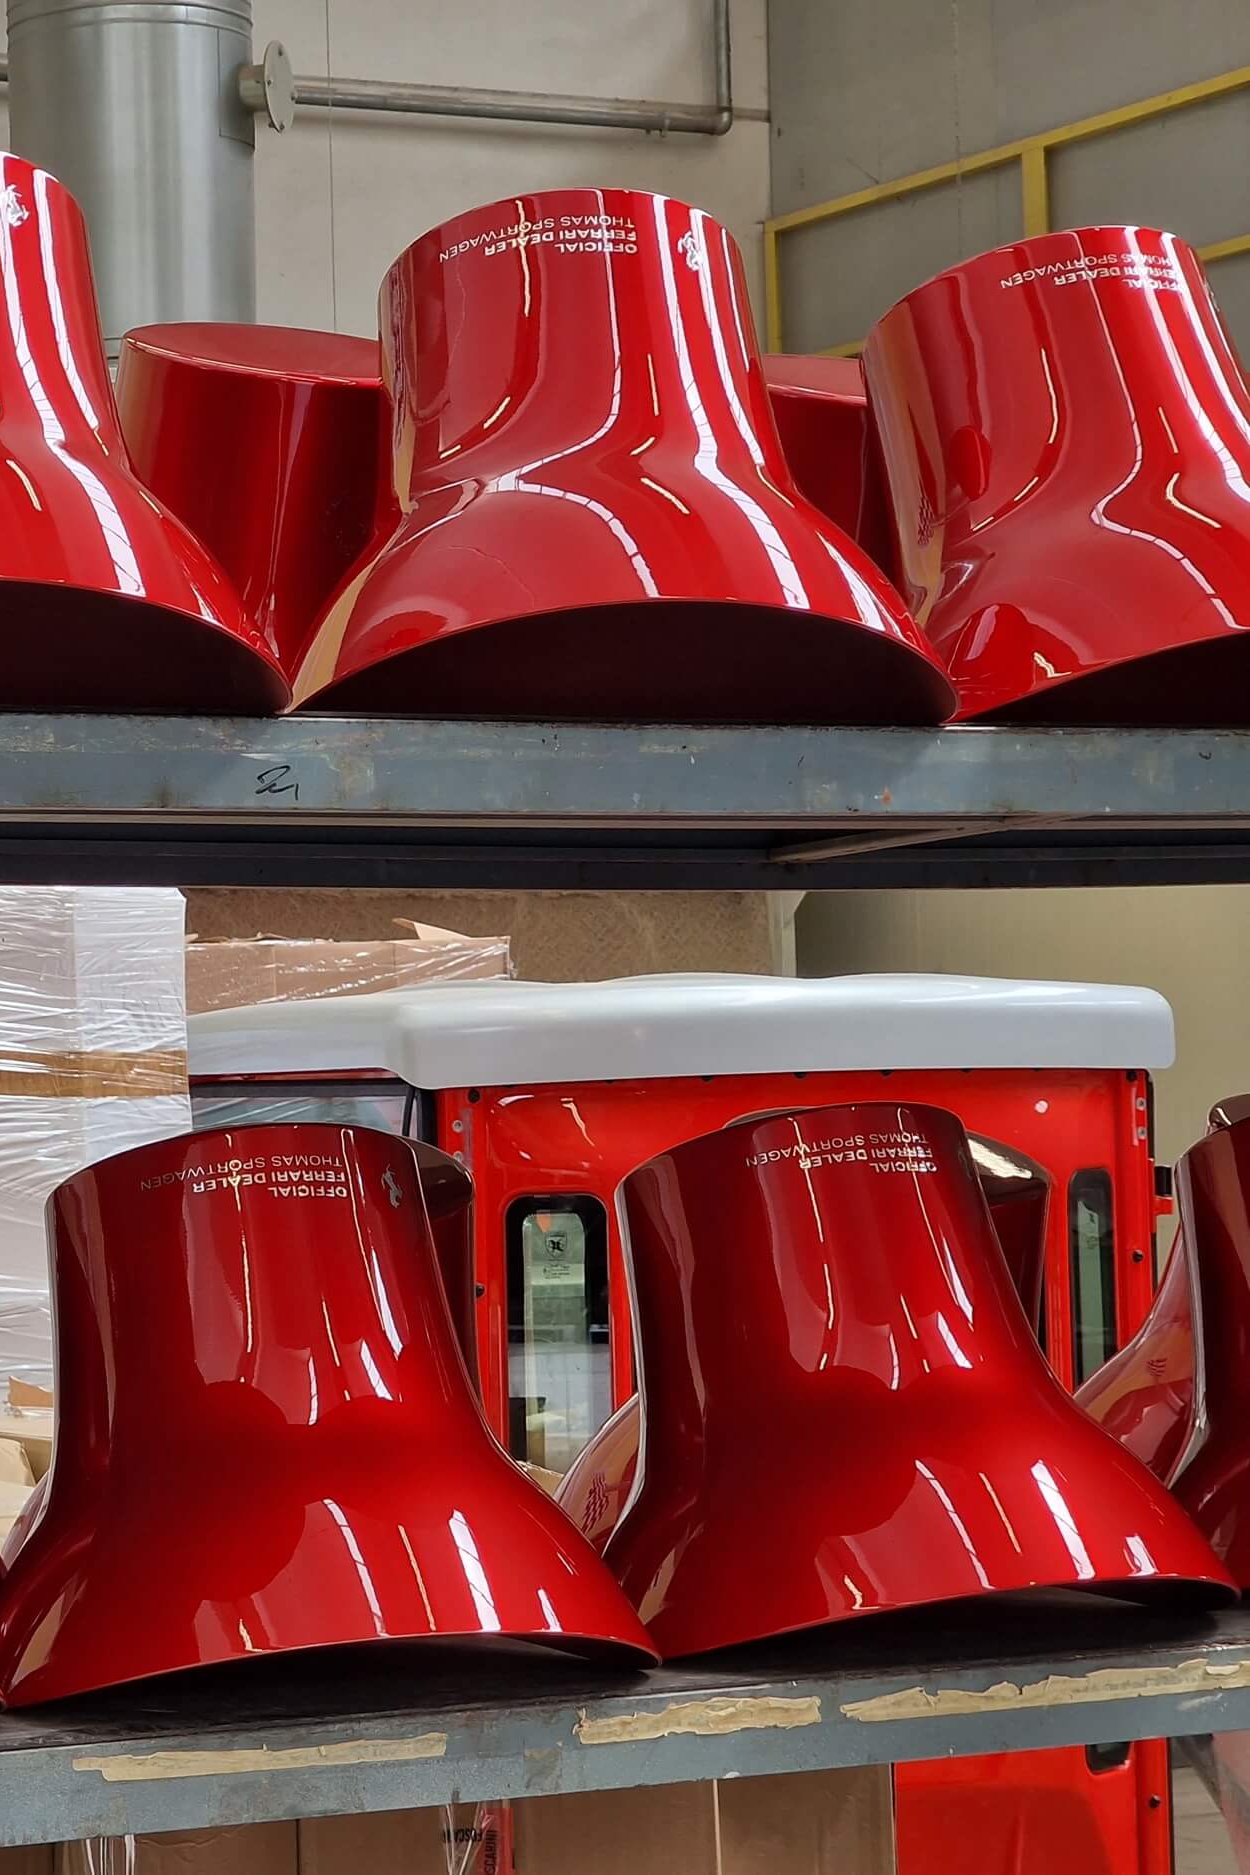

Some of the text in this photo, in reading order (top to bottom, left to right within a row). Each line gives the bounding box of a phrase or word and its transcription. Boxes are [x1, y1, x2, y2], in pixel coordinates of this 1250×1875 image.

[438, 215, 635, 263] THOMAS SPORTWAGEN
[484, 229, 637, 257] FERRARI DEALER
[555, 243, 638, 254] OFFICIAL
[1000, 254, 1117, 289] SPORTWAGEN
[1054, 266, 1120, 286] DEALER
[746, 1132, 928, 1168] THOMAS SPORTWAGEN
[799, 1146, 933, 1169] FERRARI DEALER
[140, 1155, 342, 1192] THOMAS SPORTWAGEN
[869, 1162, 937, 1173] OFFICIAL
[193, 1170, 347, 1193] FERRARI DEALER
[268, 1185, 348, 1198] OFFICIAL
